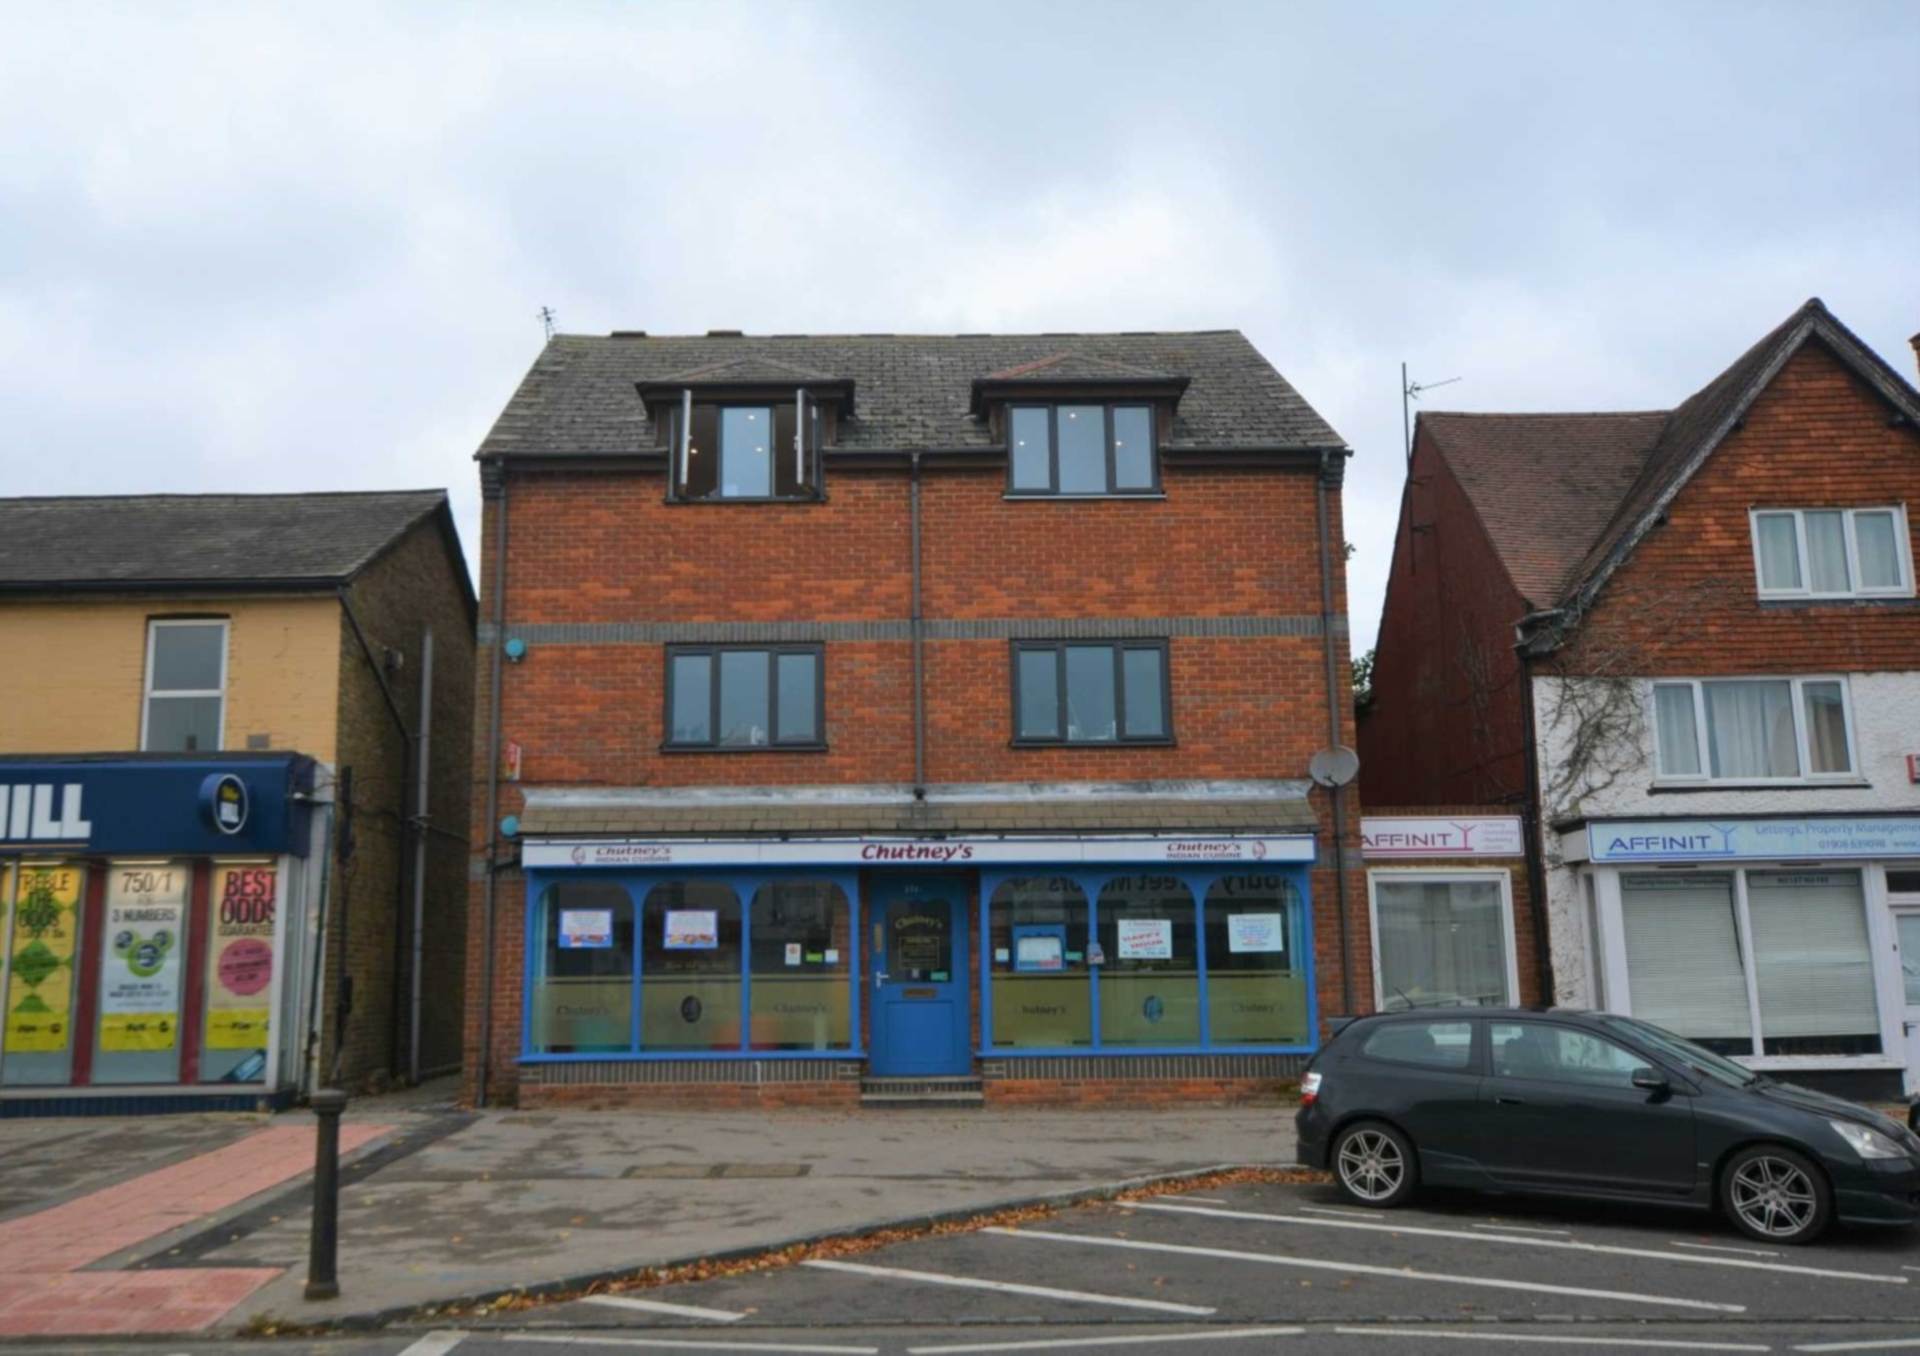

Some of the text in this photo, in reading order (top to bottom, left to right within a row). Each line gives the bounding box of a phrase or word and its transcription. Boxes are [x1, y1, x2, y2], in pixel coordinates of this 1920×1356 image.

[0, 784, 91, 839] ILL
[1608, 823, 1738, 851] AFFINITY
[1806, 823, 1852, 837] Property
[595, 846, 671, 856] Chutney's
[861, 843, 974, 861] Chutney's
[1167, 842, 1242, 852] Chutney's
[122, 871, 173, 893] 750/1
[225, 870, 278, 897] BEST
[112, 907, 176, 922] 3 NUMBERS
[220, 898, 276, 924] ODDS
